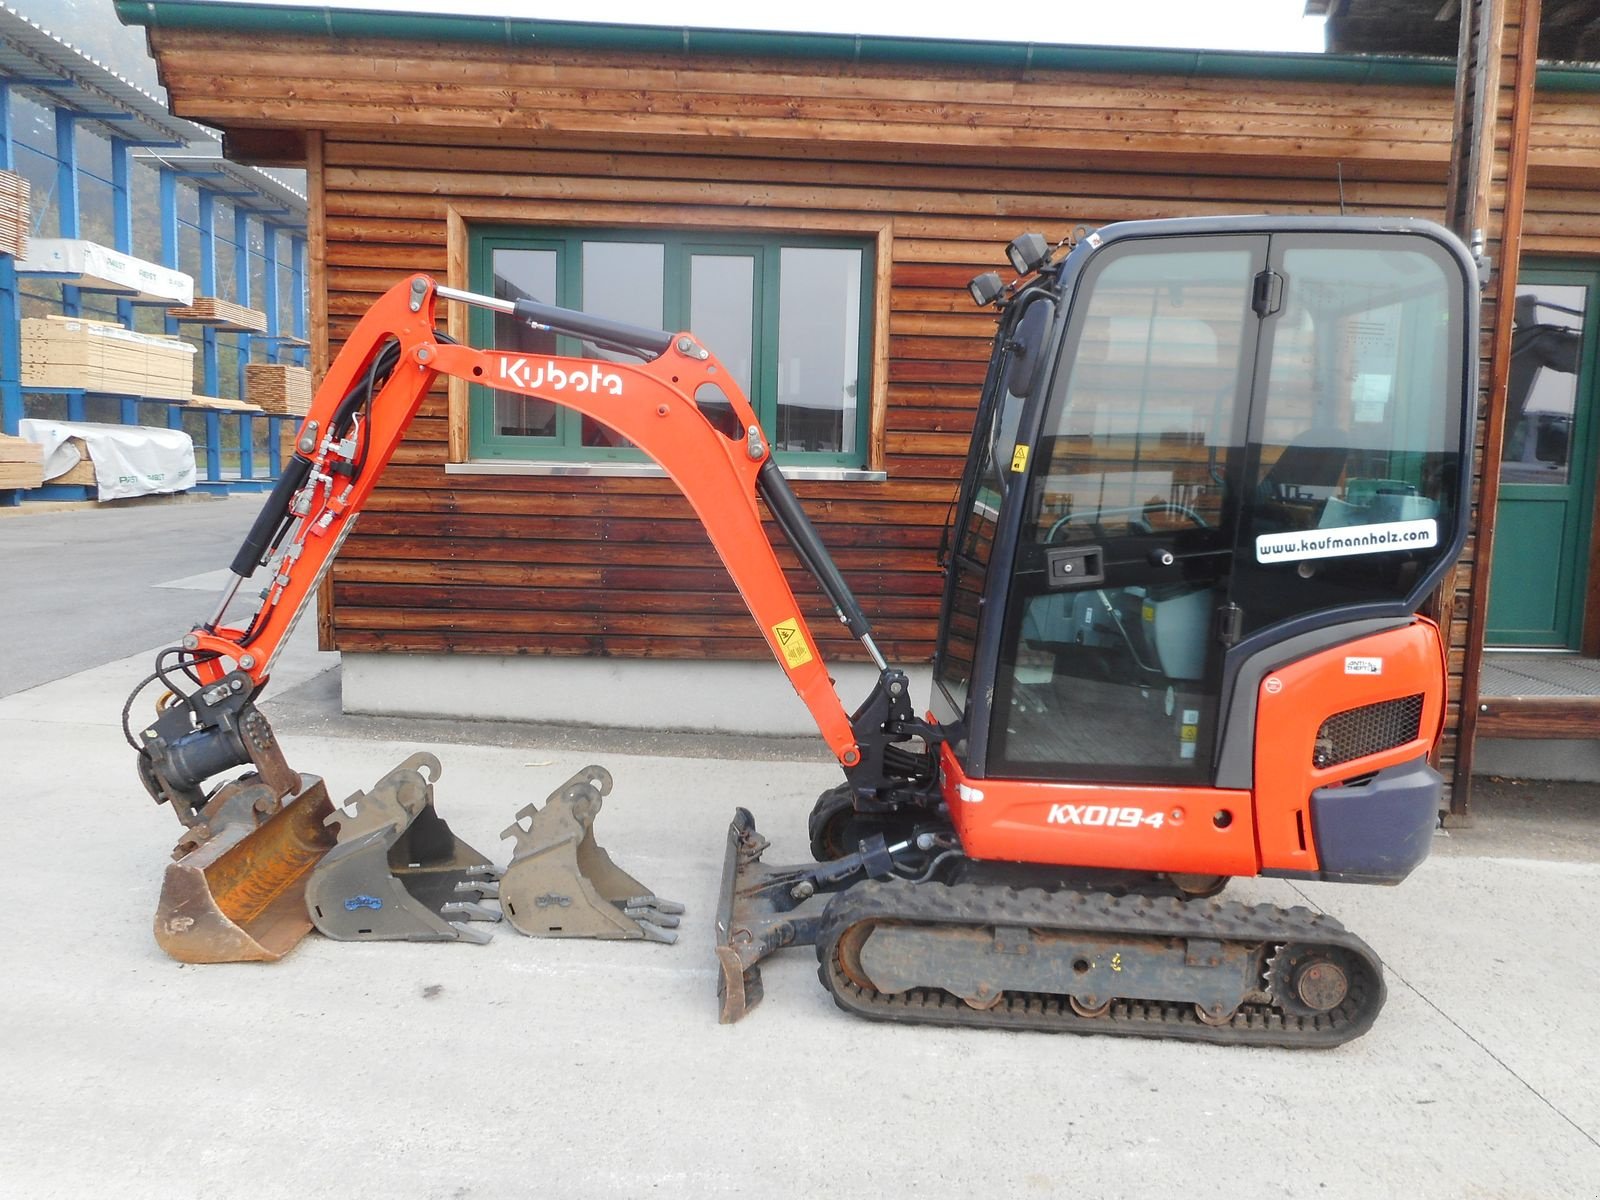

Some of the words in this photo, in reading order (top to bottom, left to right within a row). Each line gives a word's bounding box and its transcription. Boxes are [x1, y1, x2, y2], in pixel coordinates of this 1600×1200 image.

[500, 357, 623, 396] Kubota
[1259, 529, 1430, 556] www.kaufmannholz.com
[1047, 804, 1165, 829] KX019-4
